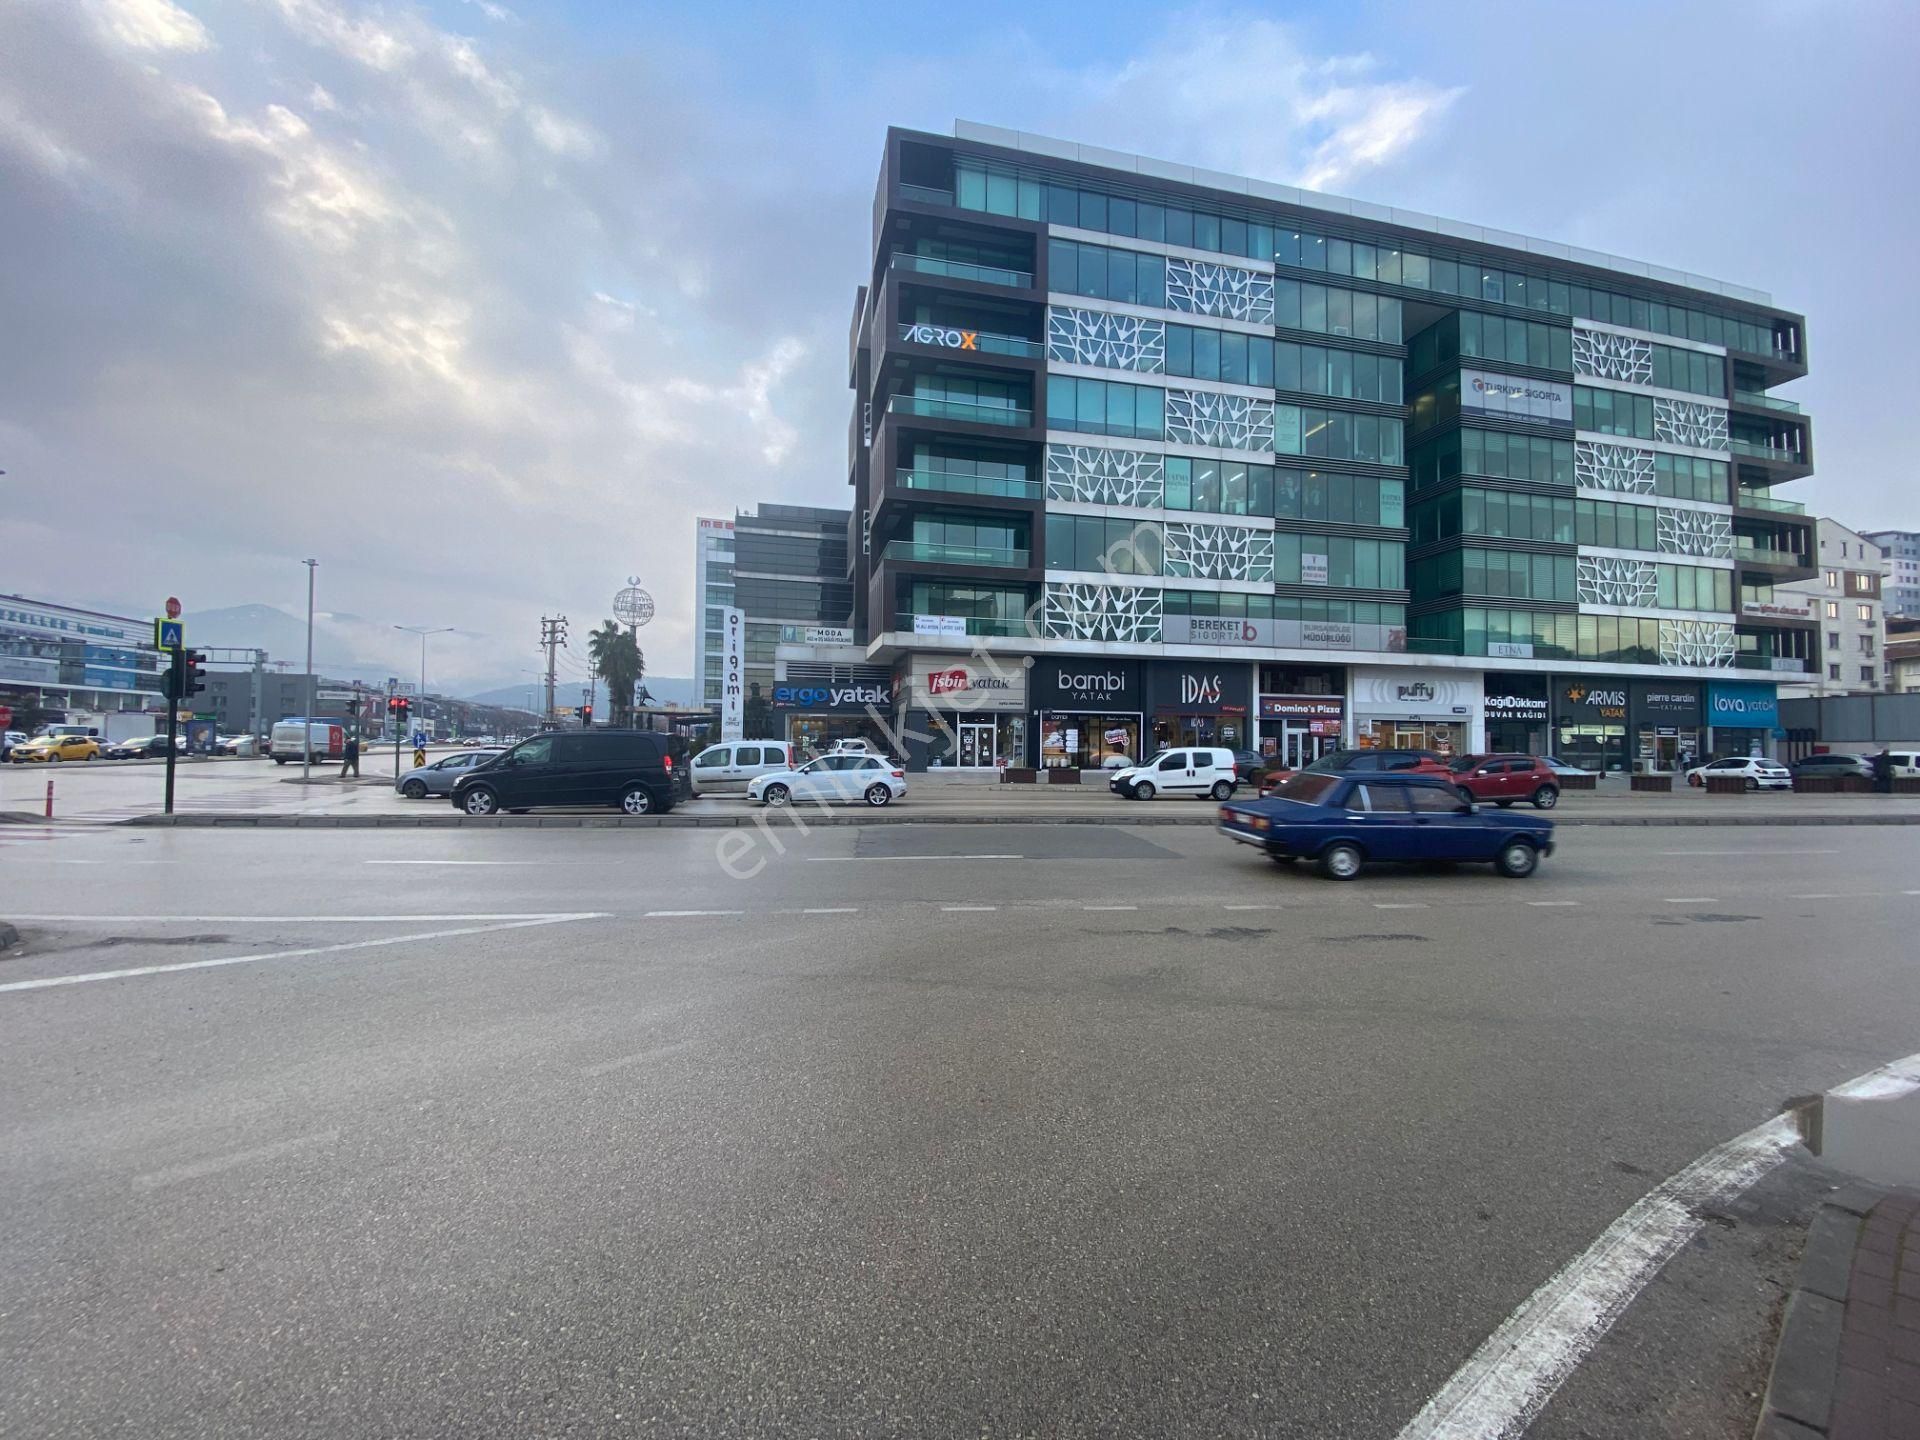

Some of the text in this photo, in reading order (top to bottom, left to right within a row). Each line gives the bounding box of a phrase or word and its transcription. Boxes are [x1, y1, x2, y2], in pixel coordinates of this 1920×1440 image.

[903, 325, 977, 351] AGROX
[1191, 619, 1241, 631] BEREKET
[817, 629, 843, 637] MODA
[1058, 669, 1126, 691] bambi
[775, 685, 890, 708] ergo yatak
[1071, 691, 1113, 701] YATAK
[1397, 682, 1435, 701] puffy
[1646, 692, 1695, 703] pierre cardin
[1274, 703, 1341, 714] Domino's Pizza
